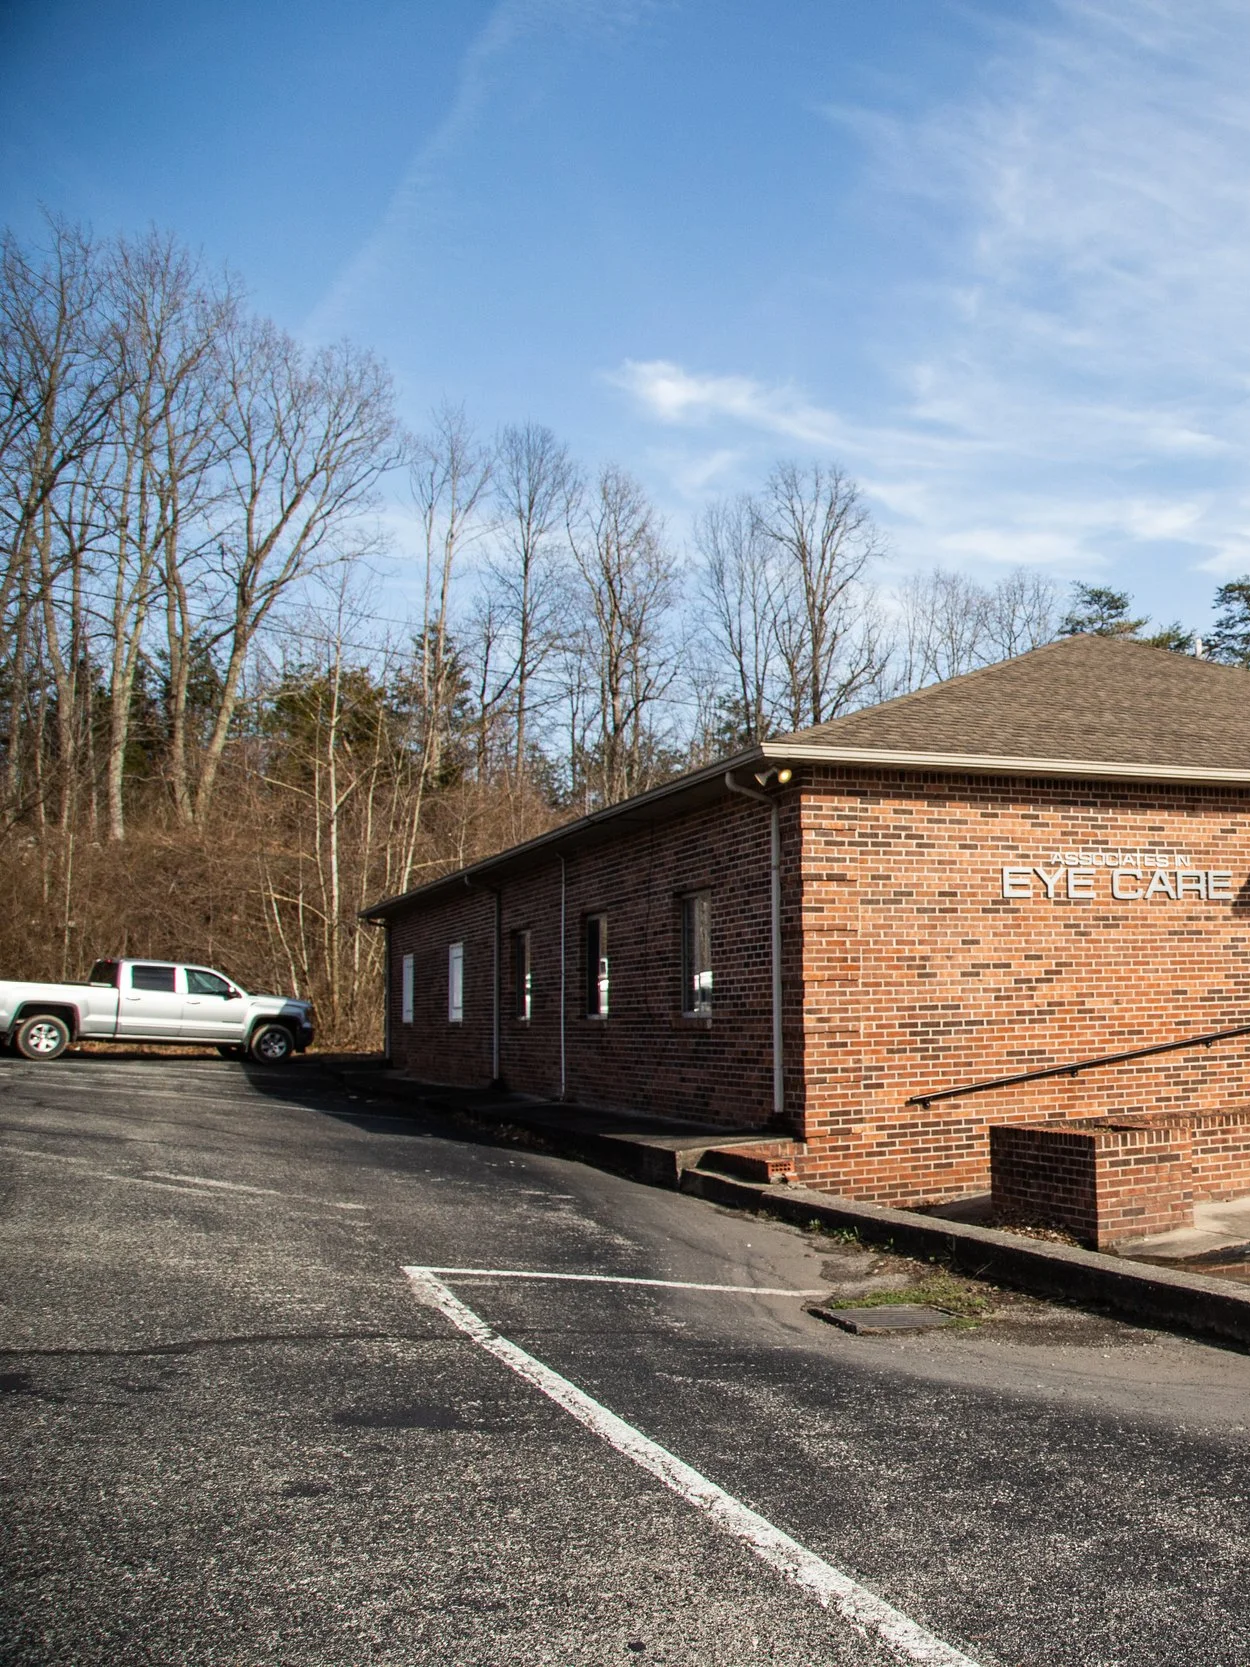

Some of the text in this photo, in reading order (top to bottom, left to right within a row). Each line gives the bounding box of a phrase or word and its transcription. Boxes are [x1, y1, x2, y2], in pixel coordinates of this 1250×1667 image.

[1051, 852, 1191, 867] ASSOCIATES IN
[1002, 867, 1234, 900] EYE CARE
